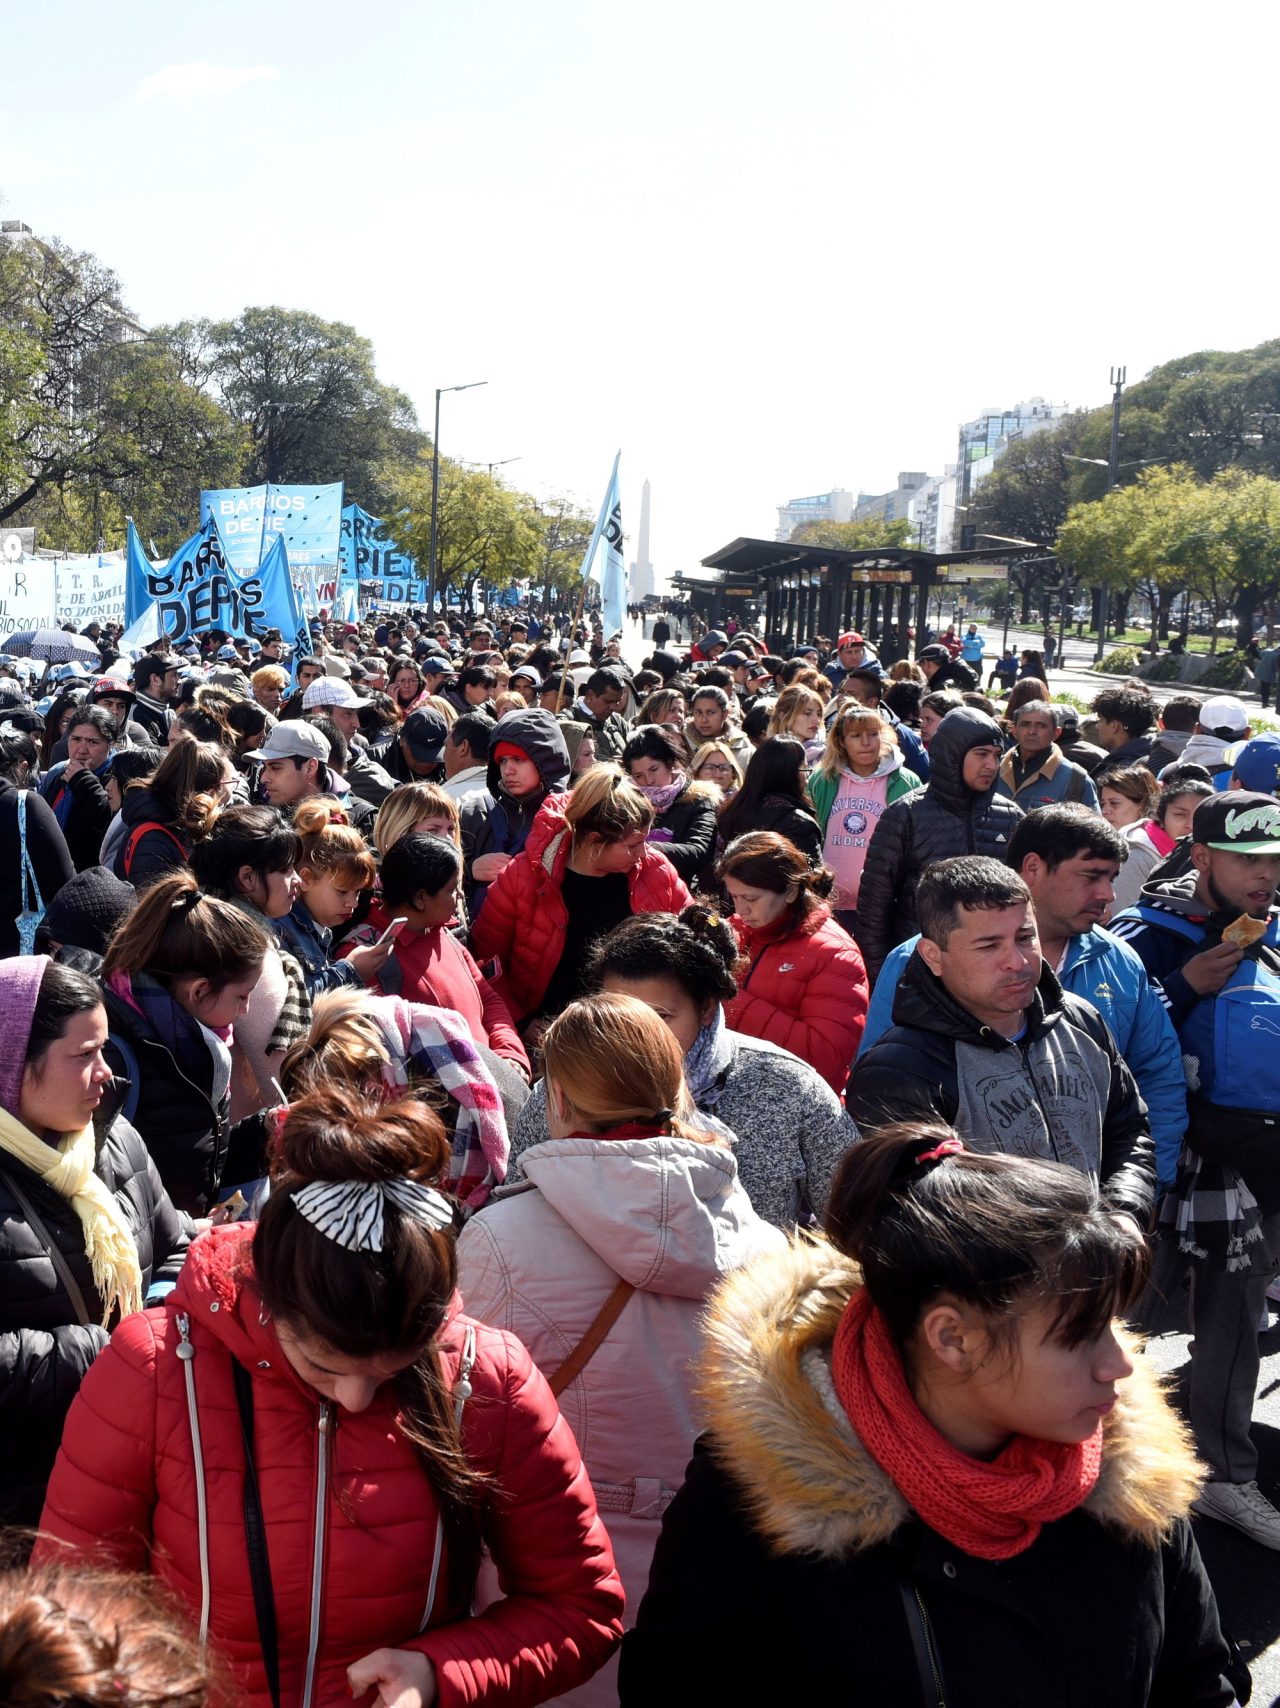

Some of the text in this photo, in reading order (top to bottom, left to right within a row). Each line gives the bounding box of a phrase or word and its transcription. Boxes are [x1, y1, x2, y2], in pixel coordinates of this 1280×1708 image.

[225, 517, 253, 534] DE
[14, 572, 28, 597] R
[830, 797, 887, 818] NIVERSIT
[832, 834, 868, 848] ROM
[990, 1085, 1034, 1129] JACK
